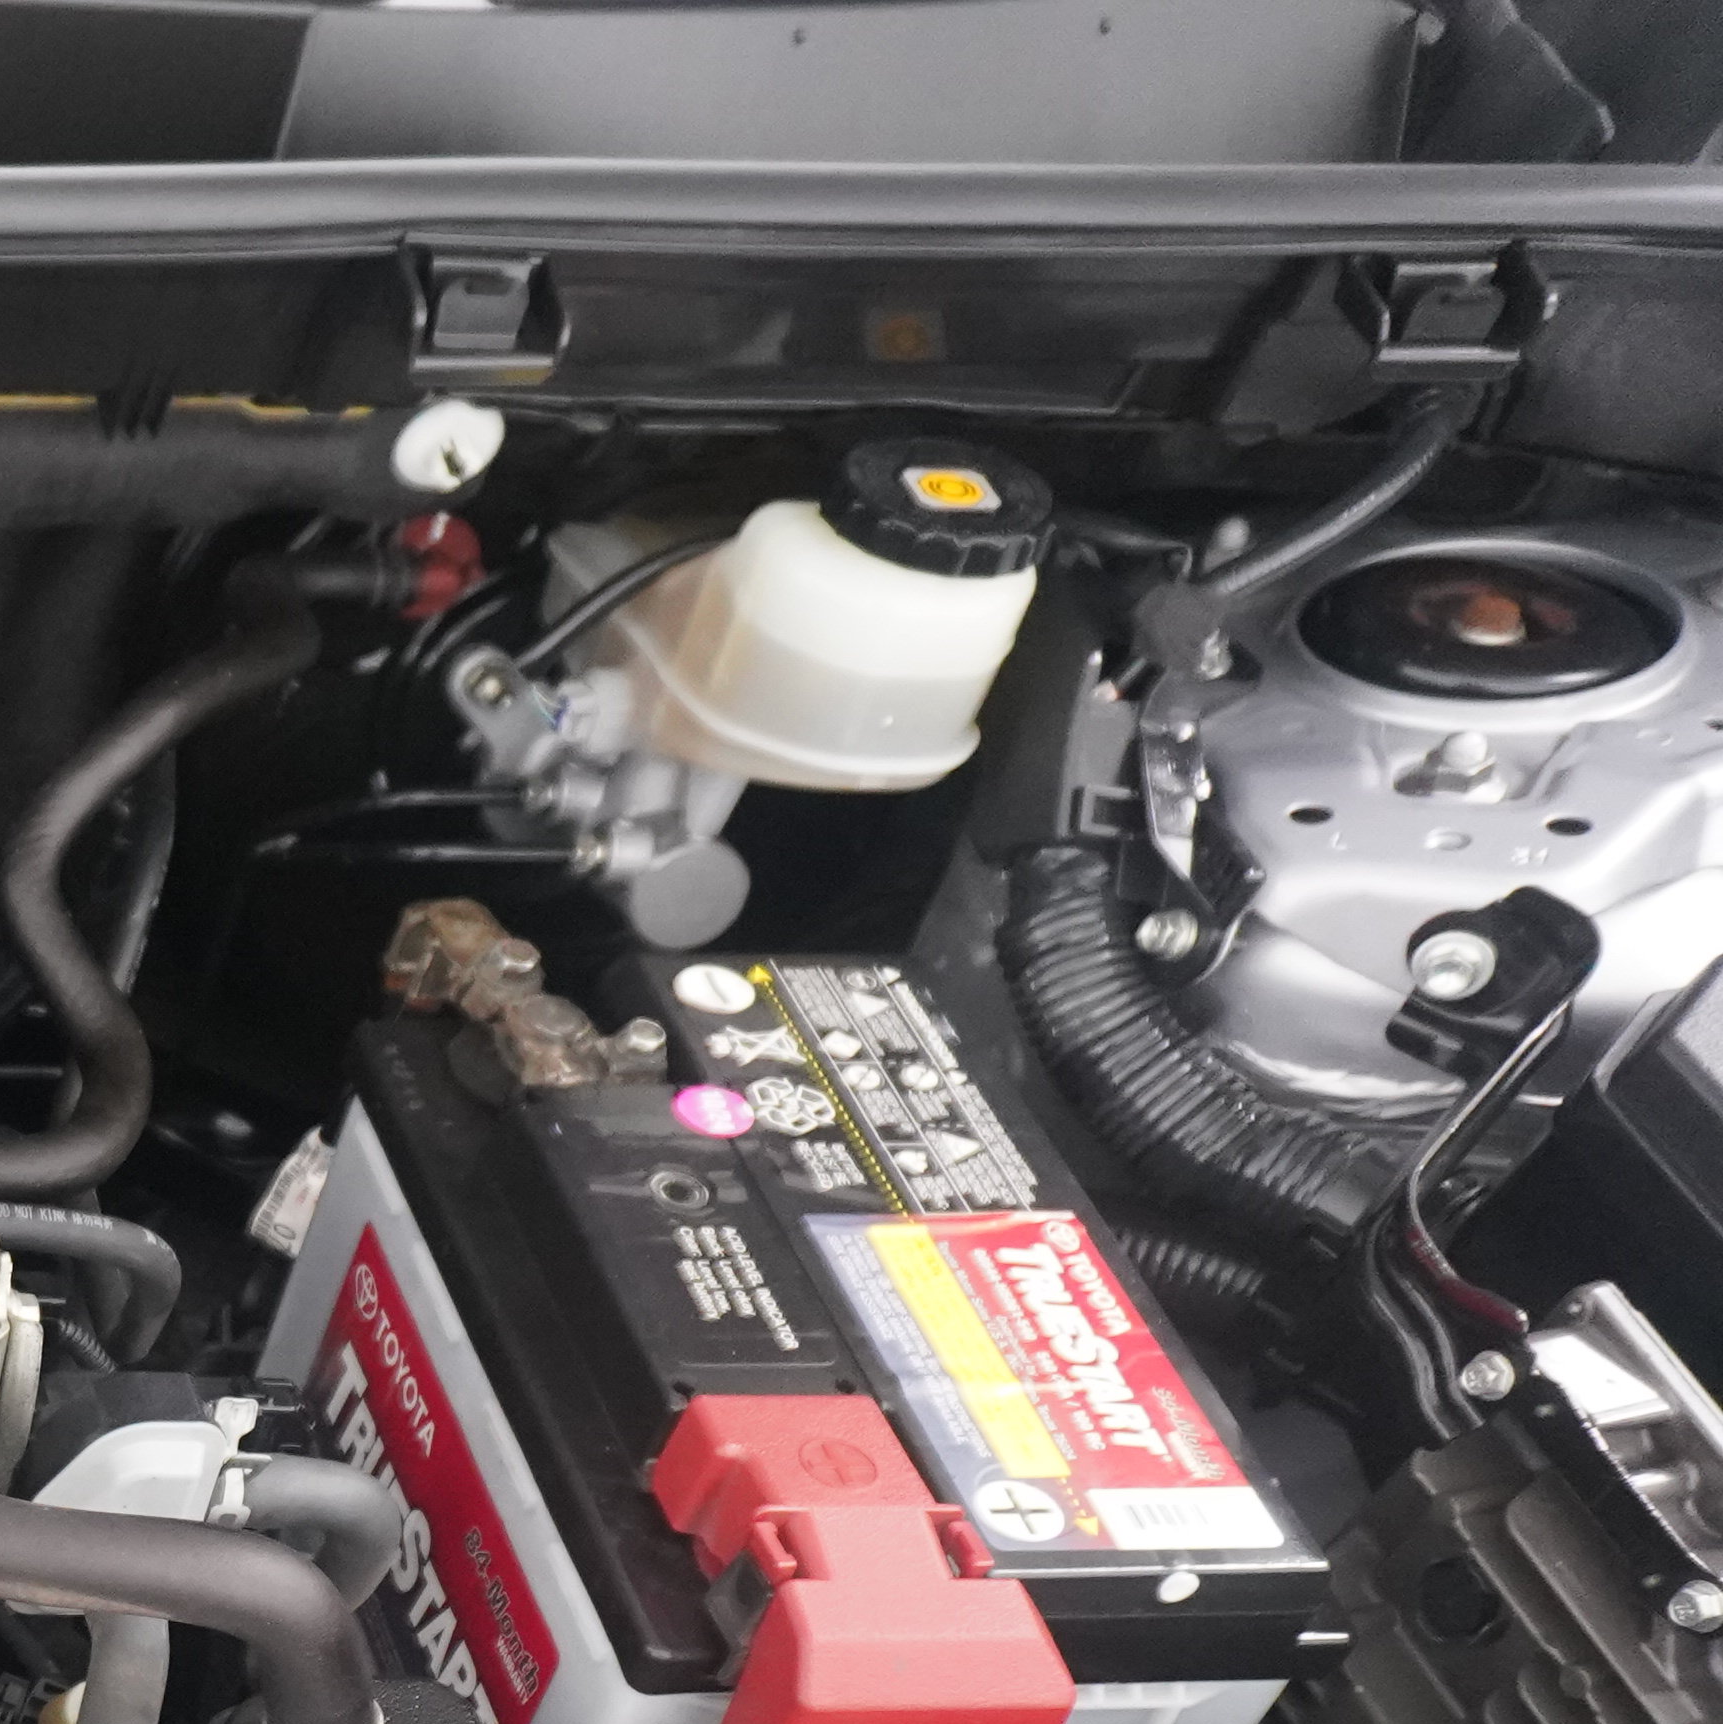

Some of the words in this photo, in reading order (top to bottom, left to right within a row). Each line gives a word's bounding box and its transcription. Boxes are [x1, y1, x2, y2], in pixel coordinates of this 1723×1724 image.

[14, 1205, 34, 1221] NOT
[39, 1207, 68, 1223] KINK
[717, 1226, 747, 1254] ACID
[732, 1252, 764, 1287] LEVEL
[754, 1286, 799, 1351] INDICATOR
[1063, 1252, 1133, 1337] TOYOTA
[375, 1308, 436, 1458] TOYOTA
[463, 1526, 542, 1702] 84-Month
